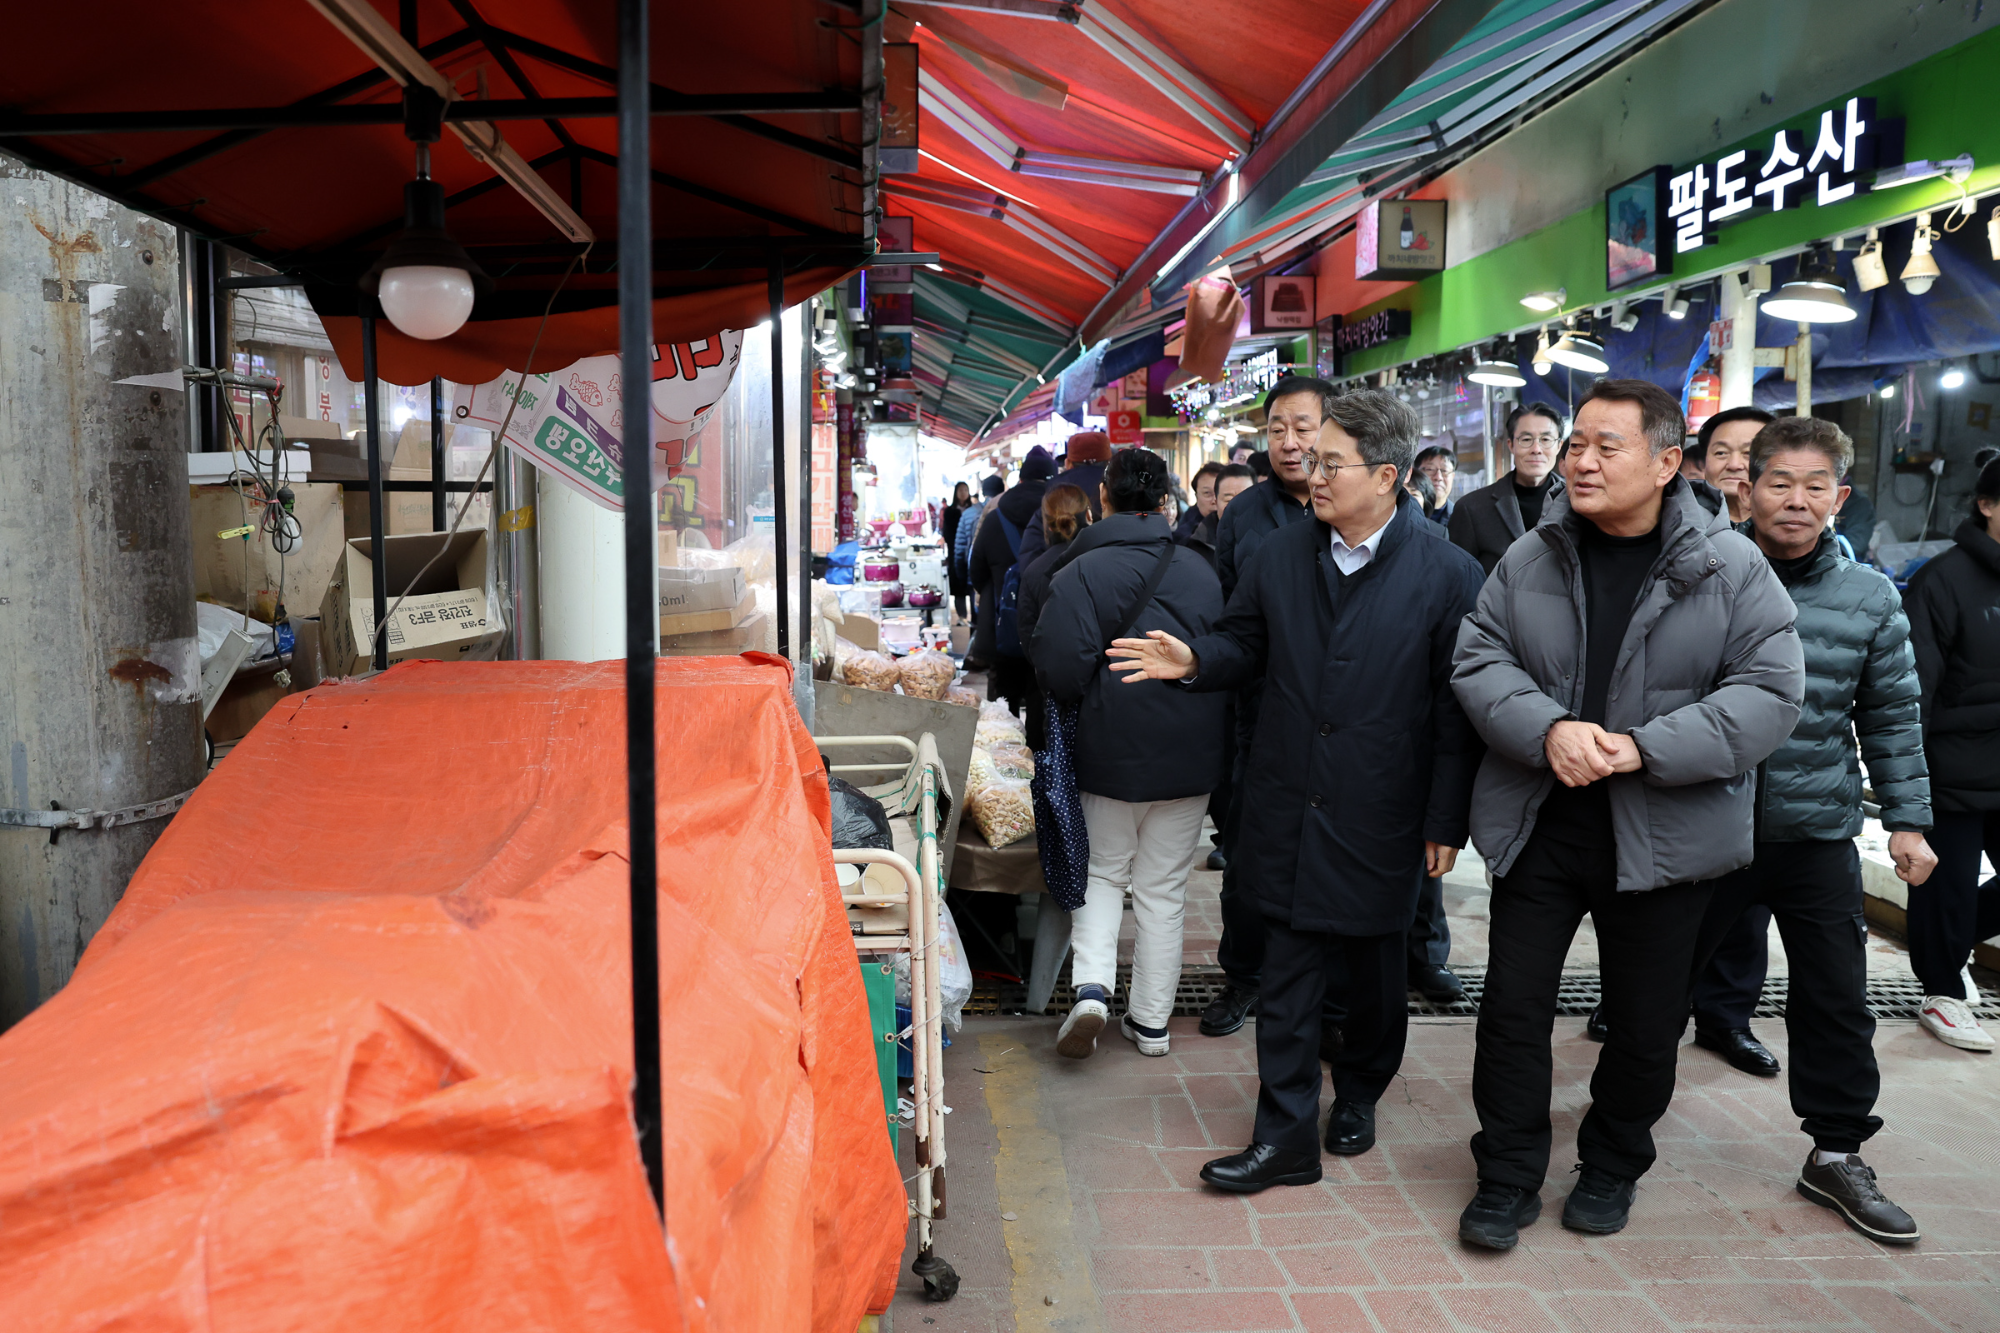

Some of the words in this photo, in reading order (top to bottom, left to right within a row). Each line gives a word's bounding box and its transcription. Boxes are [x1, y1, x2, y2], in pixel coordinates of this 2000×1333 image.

[1668, 97, 1865, 253] 팔도수산
[408, 610, 437, 626] 금F3
[438, 605, 474, 622] 진간장
[460, 621, 478, 630] 샘표
